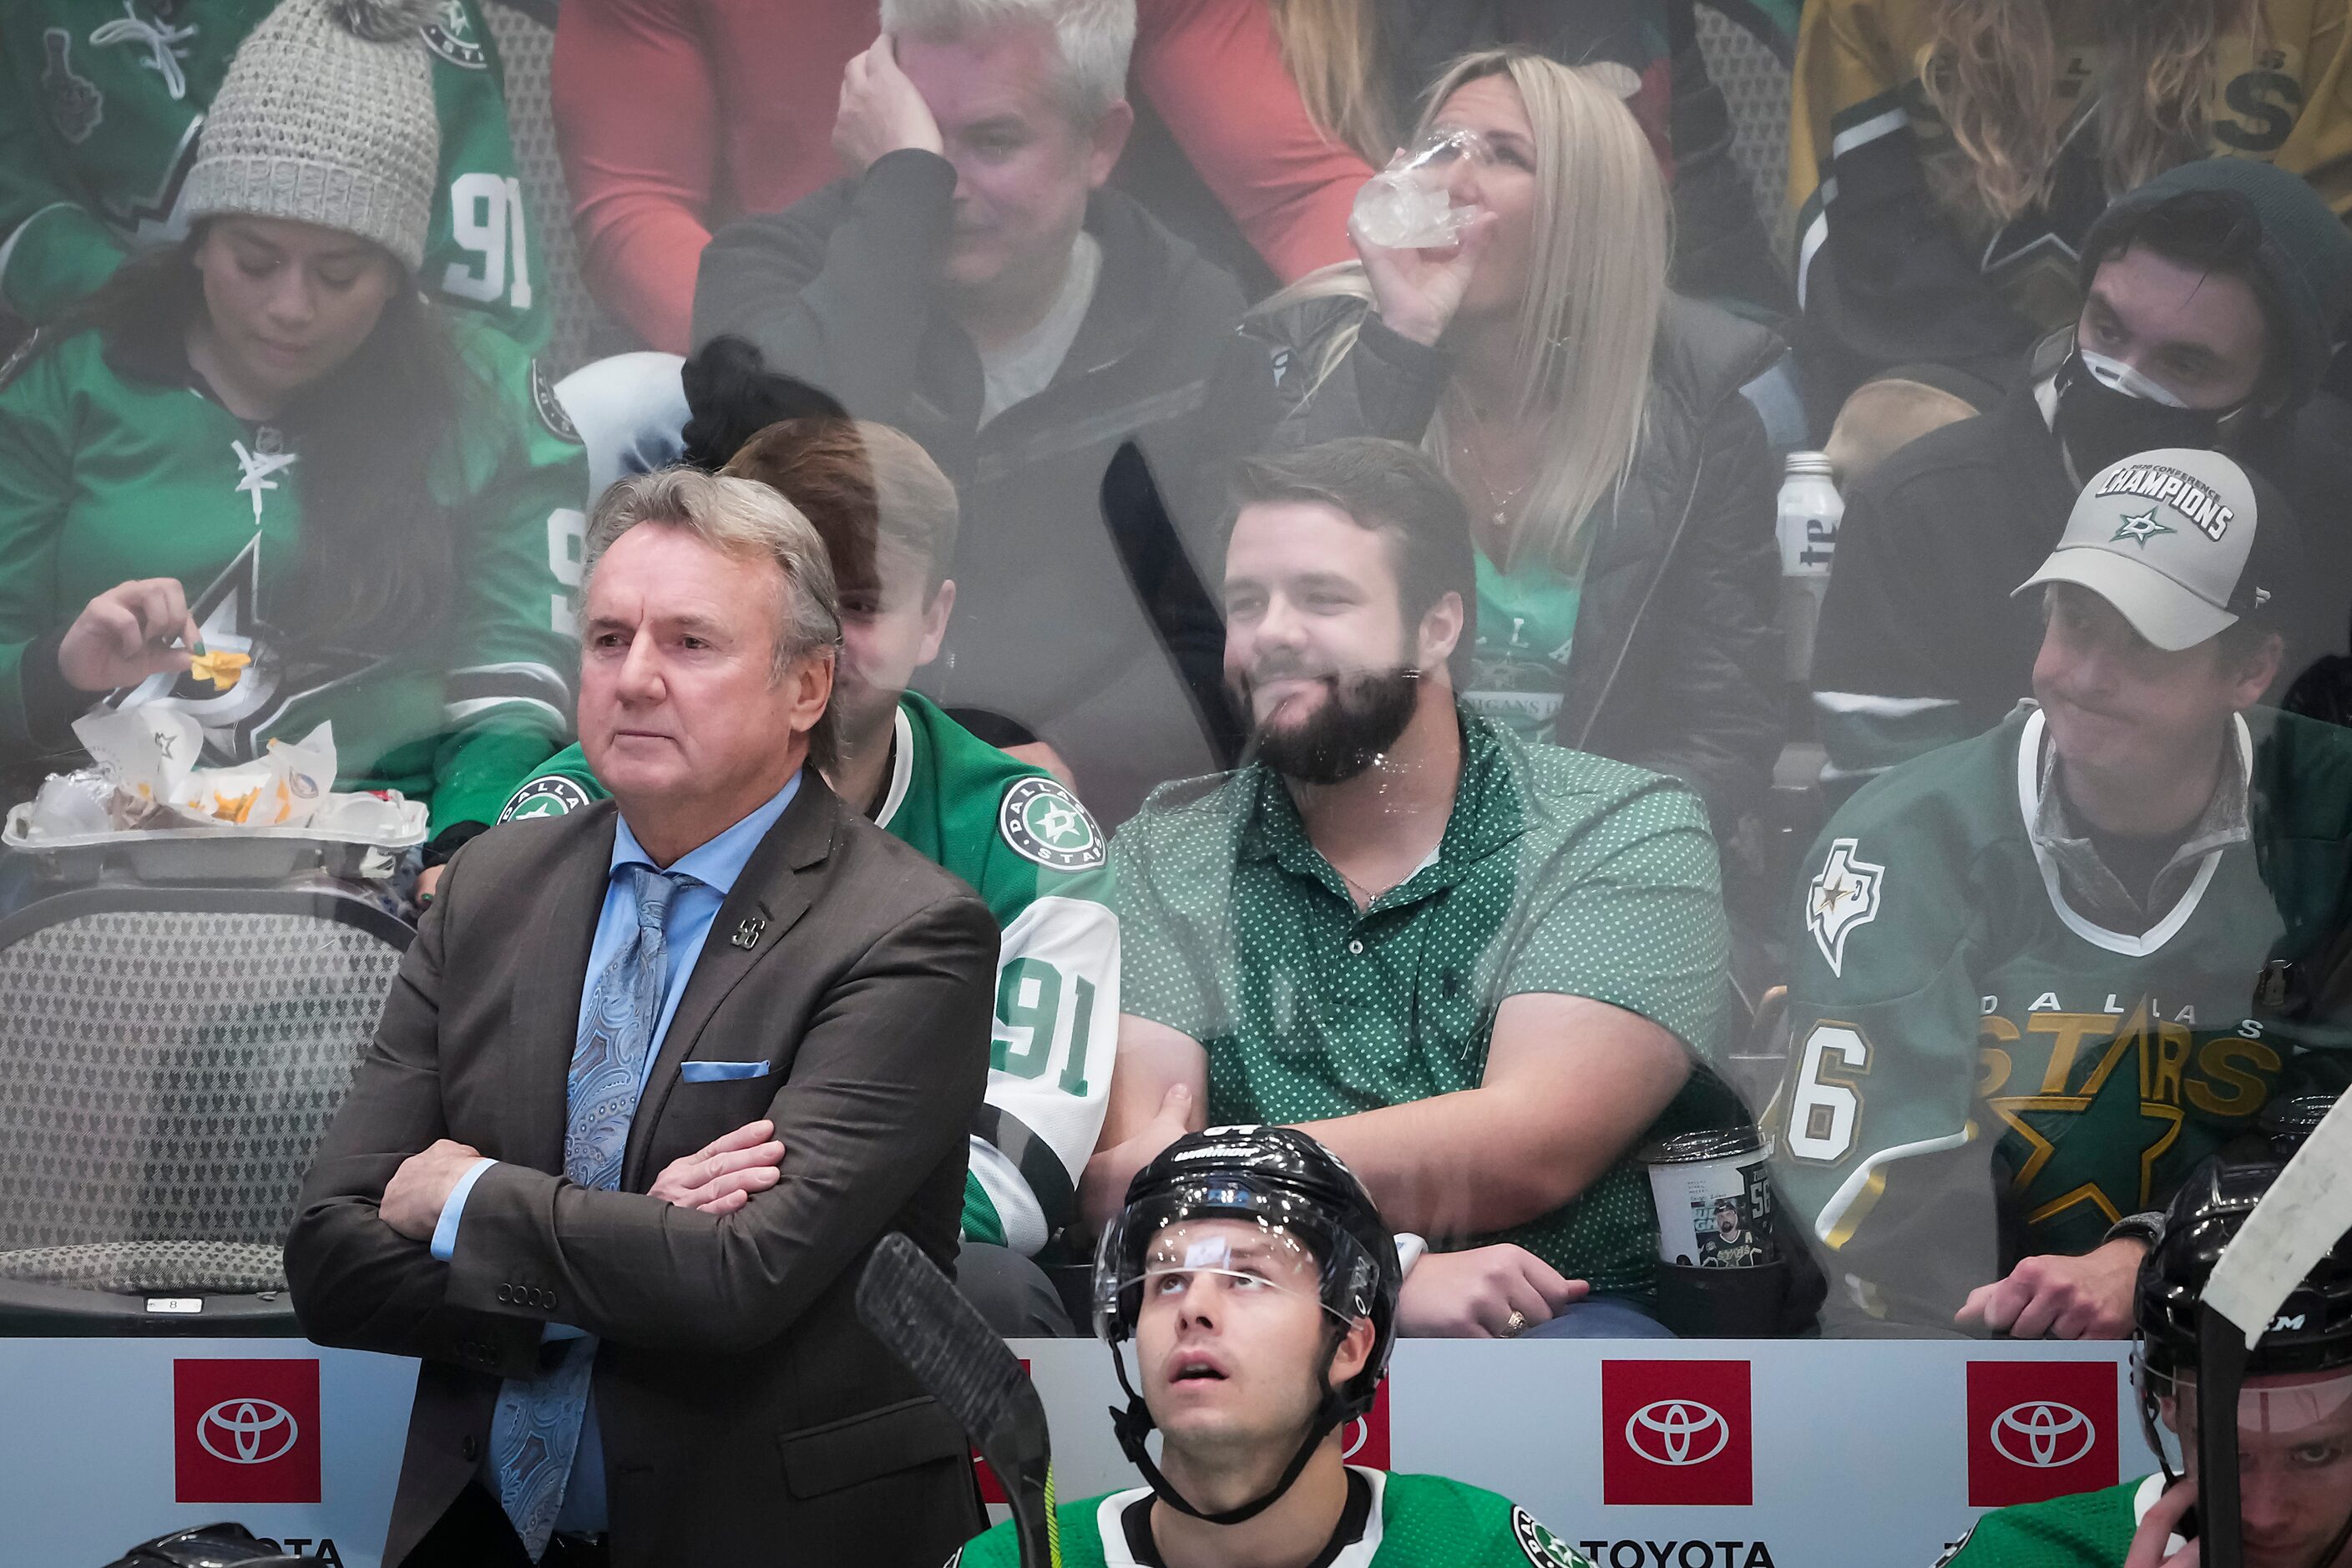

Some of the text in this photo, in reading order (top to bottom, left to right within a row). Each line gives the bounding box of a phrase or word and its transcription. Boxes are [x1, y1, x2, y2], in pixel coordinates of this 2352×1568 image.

[442, 172, 532, 311] 91
[2095, 468, 2235, 543] CHAMPIONS
[2152, 465, 2222, 503] CONFERENCE
[547, 508, 587, 641] 9
[502, 782, 579, 821] DALLA
[1009, 782, 1085, 833] DALLAS
[1037, 837, 1103, 864] STARS
[989, 957, 1096, 1098] 91
[1980, 991, 2264, 1039] DALLAS
[1975, 989, 2282, 1116] STARS
[1785, 1021, 1871, 1164] 6
[169, 1300, 177, 1309] 8
[1579, 1540, 1776, 1568] TOYOTA
